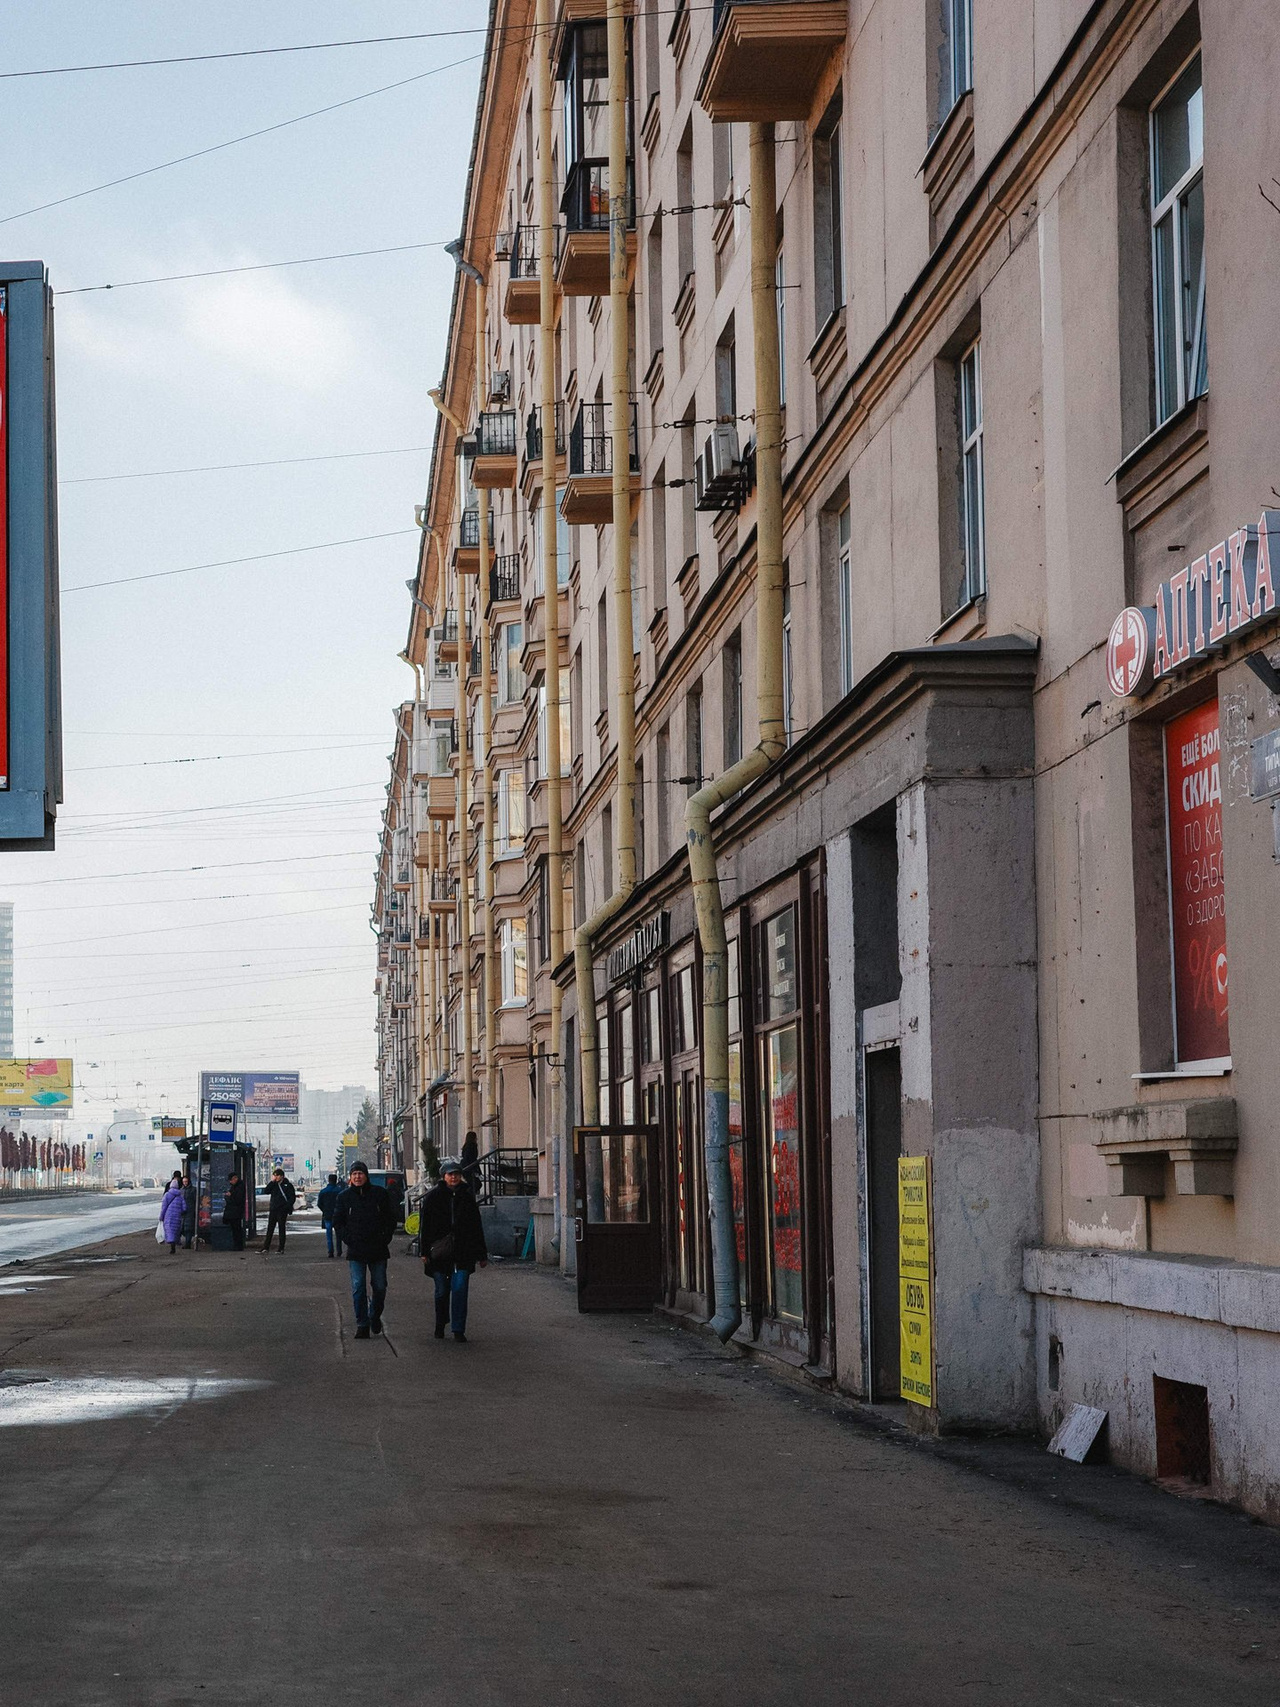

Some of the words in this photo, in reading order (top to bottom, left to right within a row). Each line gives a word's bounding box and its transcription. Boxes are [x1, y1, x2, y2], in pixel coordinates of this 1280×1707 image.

[1153, 511, 1276, 680] АПТЕКА
[1181, 732, 1200, 768] ЕЩЁ
[1201, 727, 1220, 758] БОЛ
[1182, 762, 1222, 812] СКИД
[1184, 820, 1201, 856] ПО
[1205, 812, 1223, 848] КА
[1187, 903, 1194, 926] О
[903, 1186, 923, 1202] ТРИКОТАЖ
[906, 1283, 924, 1310] ОБУВЬ
